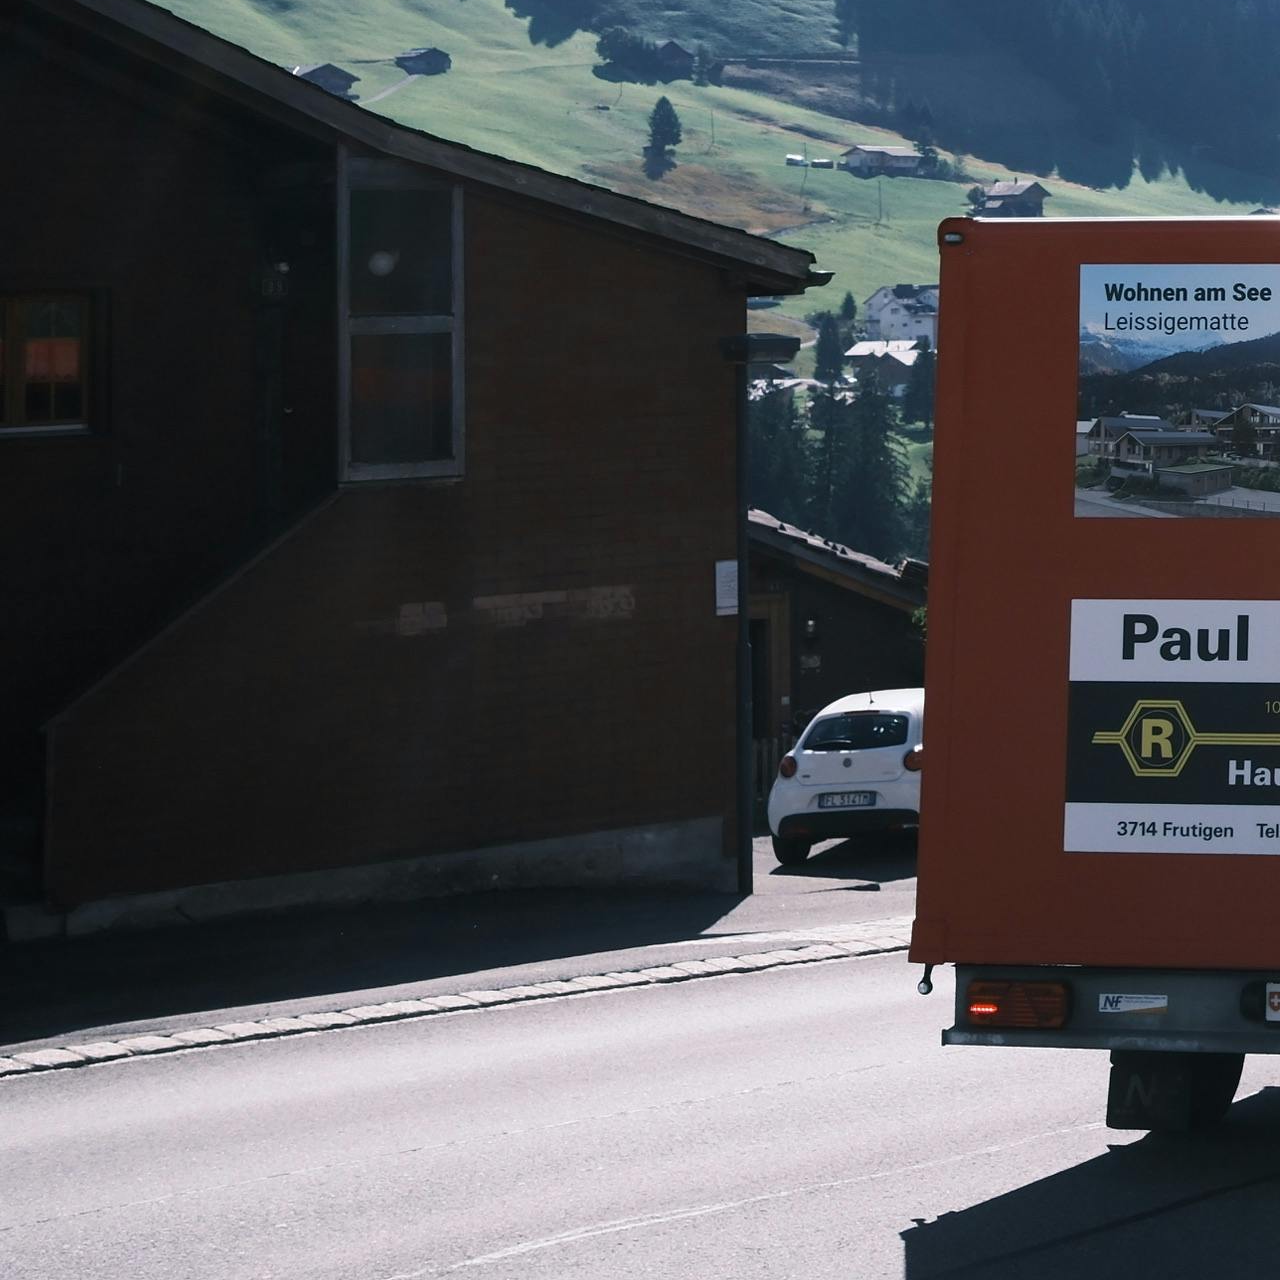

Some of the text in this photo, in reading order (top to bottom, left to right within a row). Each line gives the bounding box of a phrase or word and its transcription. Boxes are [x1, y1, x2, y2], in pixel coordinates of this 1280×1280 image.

[1105, 283, 1271, 301] Wohnen am See
[1105, 312, 1248, 335] Leissigematte
[1122, 614, 1249, 661] Paul
[1141, 717, 1174, 760] R
[1117, 821, 1233, 841] 3714 Frutigen
